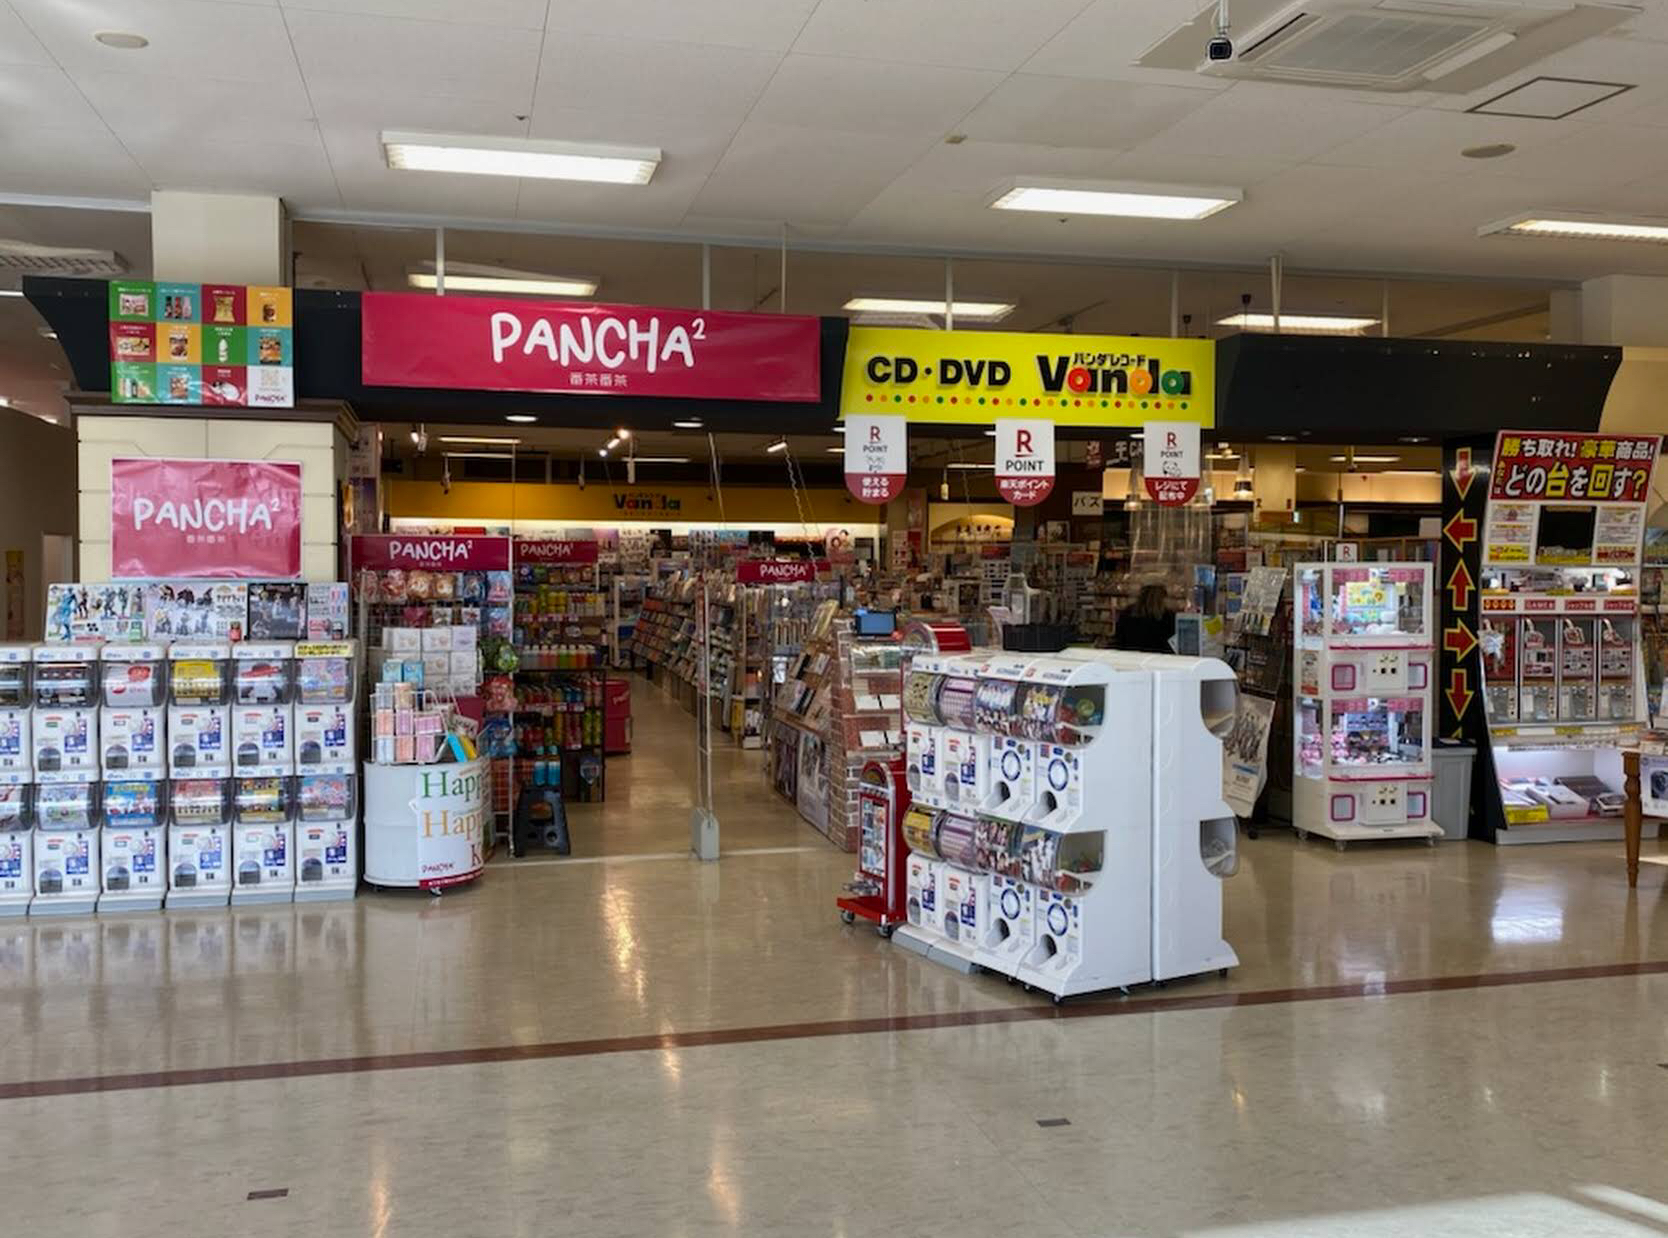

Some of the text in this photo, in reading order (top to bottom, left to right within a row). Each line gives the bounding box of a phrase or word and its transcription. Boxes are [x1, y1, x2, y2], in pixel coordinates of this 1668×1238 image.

[1036, 355, 1192, 395] Vanda
[870, 425, 881, 442] R
[1167, 431, 1177, 447] R
[1016, 429, 1034, 453] R
[863, 444, 888, 453] POINT
[1160, 451, 1183, 459] POINT
[1006, 460, 1045, 472] POINT
[1012, 490, 1037, 500] カード
